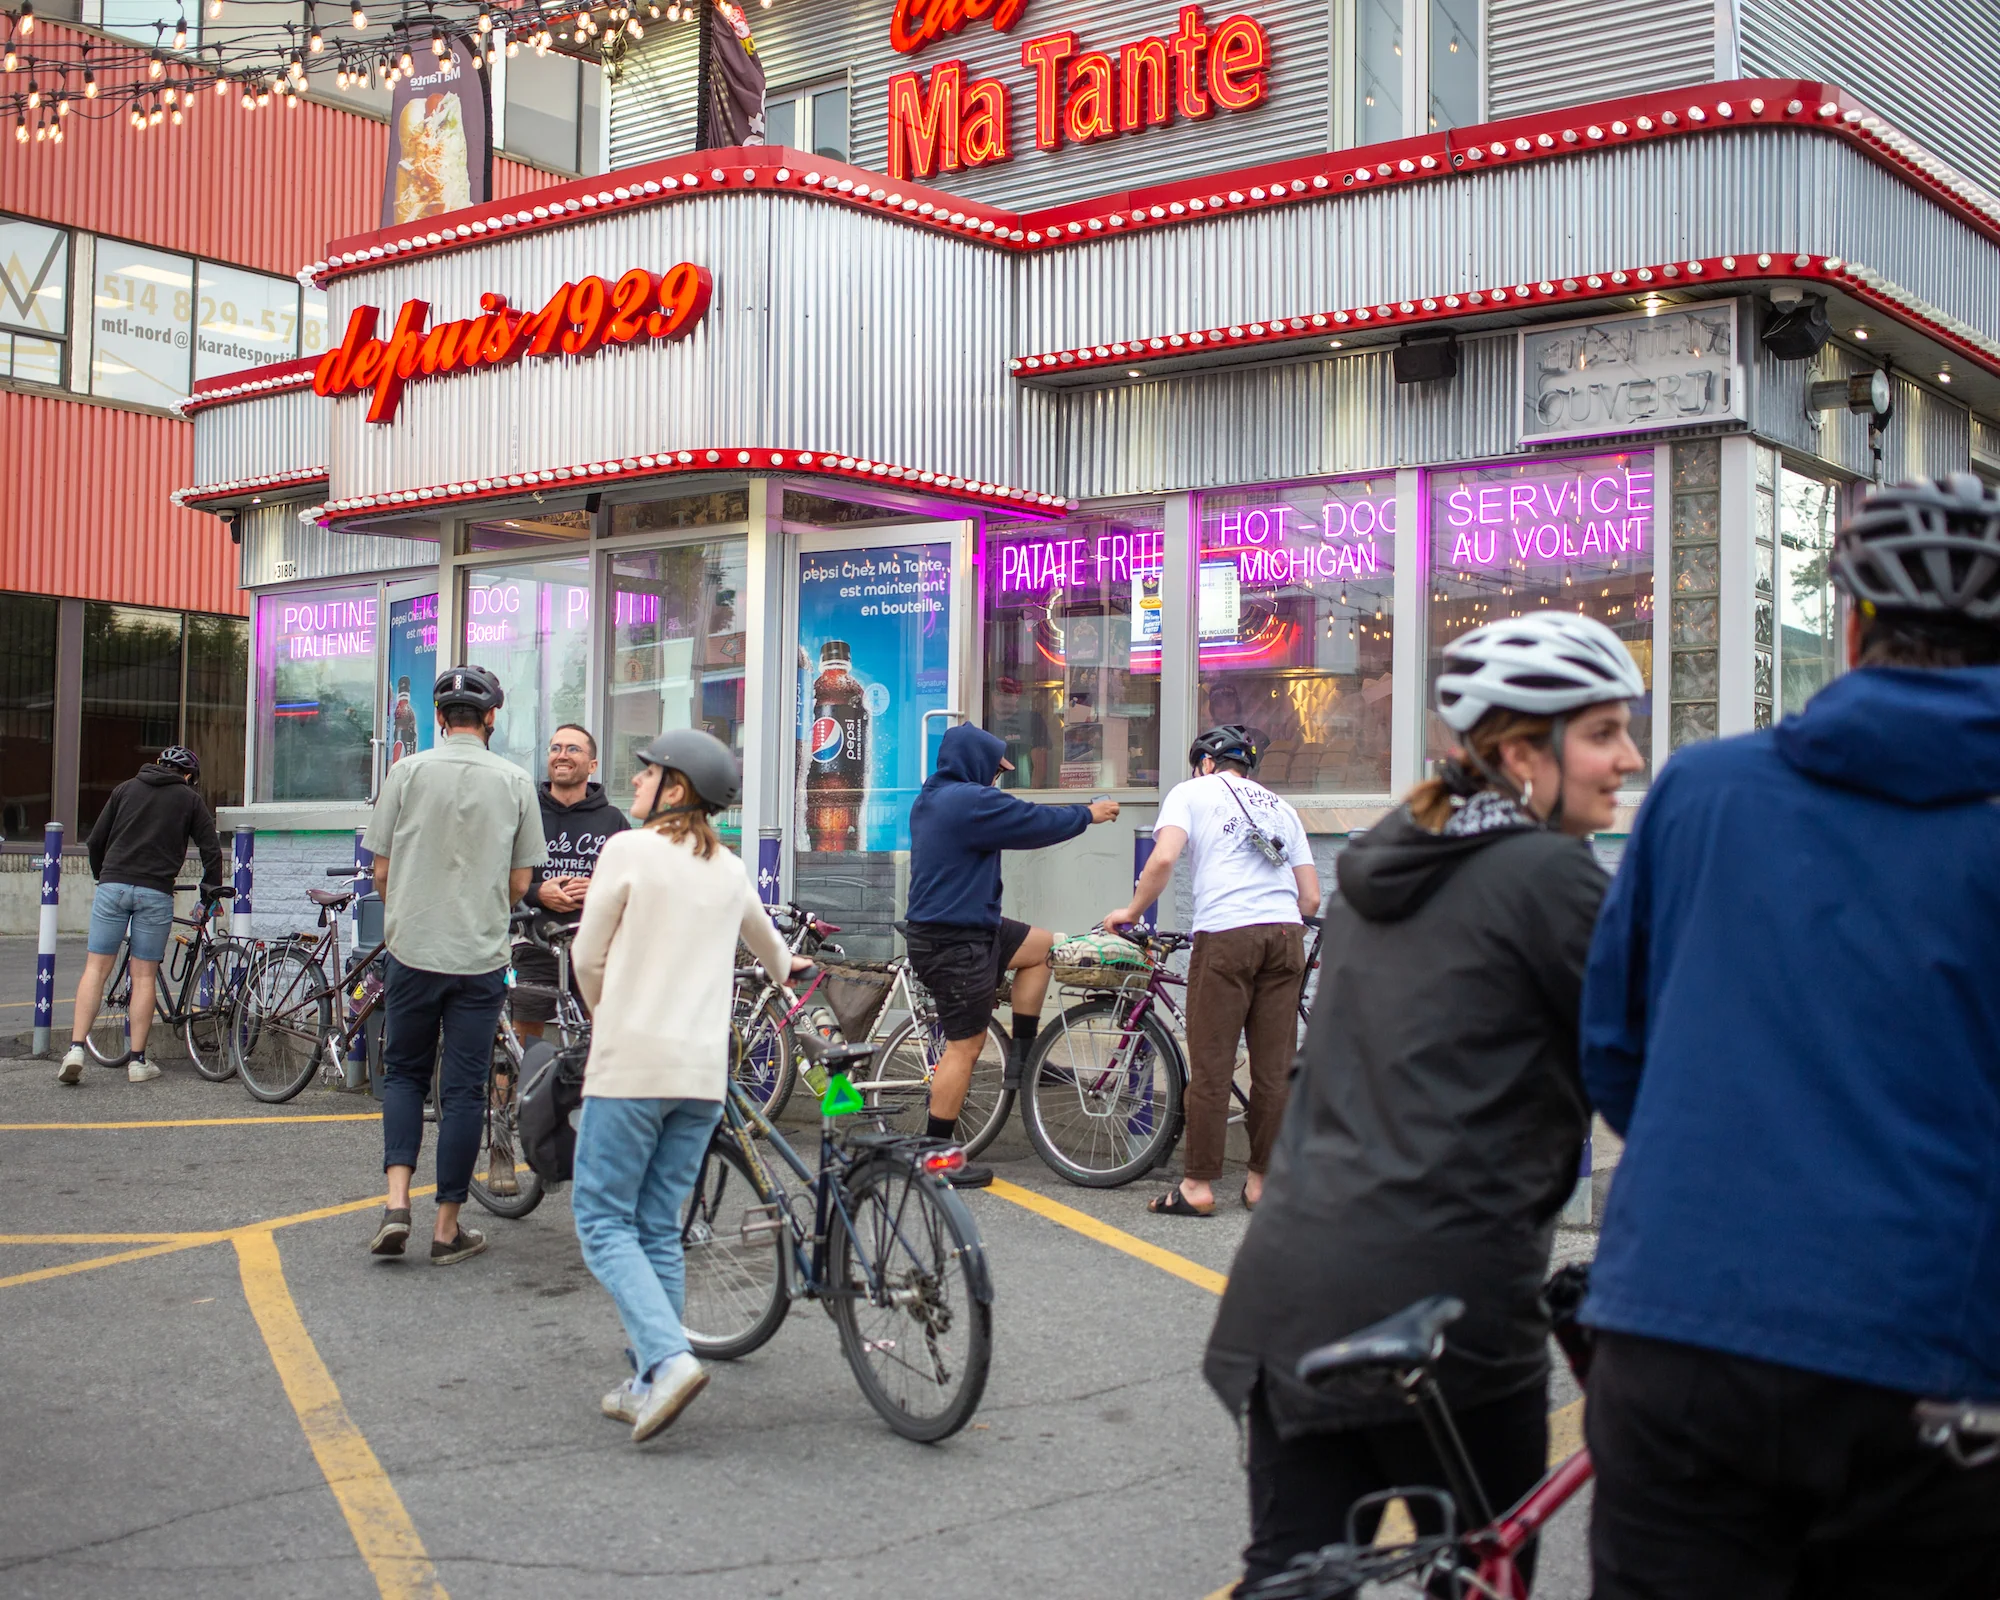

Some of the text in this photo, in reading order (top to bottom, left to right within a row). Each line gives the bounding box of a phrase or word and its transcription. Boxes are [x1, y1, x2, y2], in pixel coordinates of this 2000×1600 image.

[888, 59, 1014, 181] Ma
[1021, 4, 1272, 152] Tante
[103, 274, 329, 352] 514 829-578
[314, 261, 713, 424] depuis 1929
[1448, 473, 1653, 527] SERVICE
[1452, 516, 1650, 565] AU VOLANT
[277, 563, 293, 578] 3180
[803, 565, 839, 583] pepsi
[842, 563, 876, 578] Chez
[879, 562, 901, 574] Ma
[1002, 539, 1086, 591] PATATE
[1239, 542, 1377, 582] MICHIGAN
[472, 586, 521, 615] DOG
[840, 579, 946, 598] est maintenant
[861, 598, 945, 616] en bouteille.
[284, 598, 378, 635] POUTINE
[466, 619, 508, 643] Boeuf
[290, 628, 372, 659] ITALIENNE
[845, 718, 857, 760] pepsi
